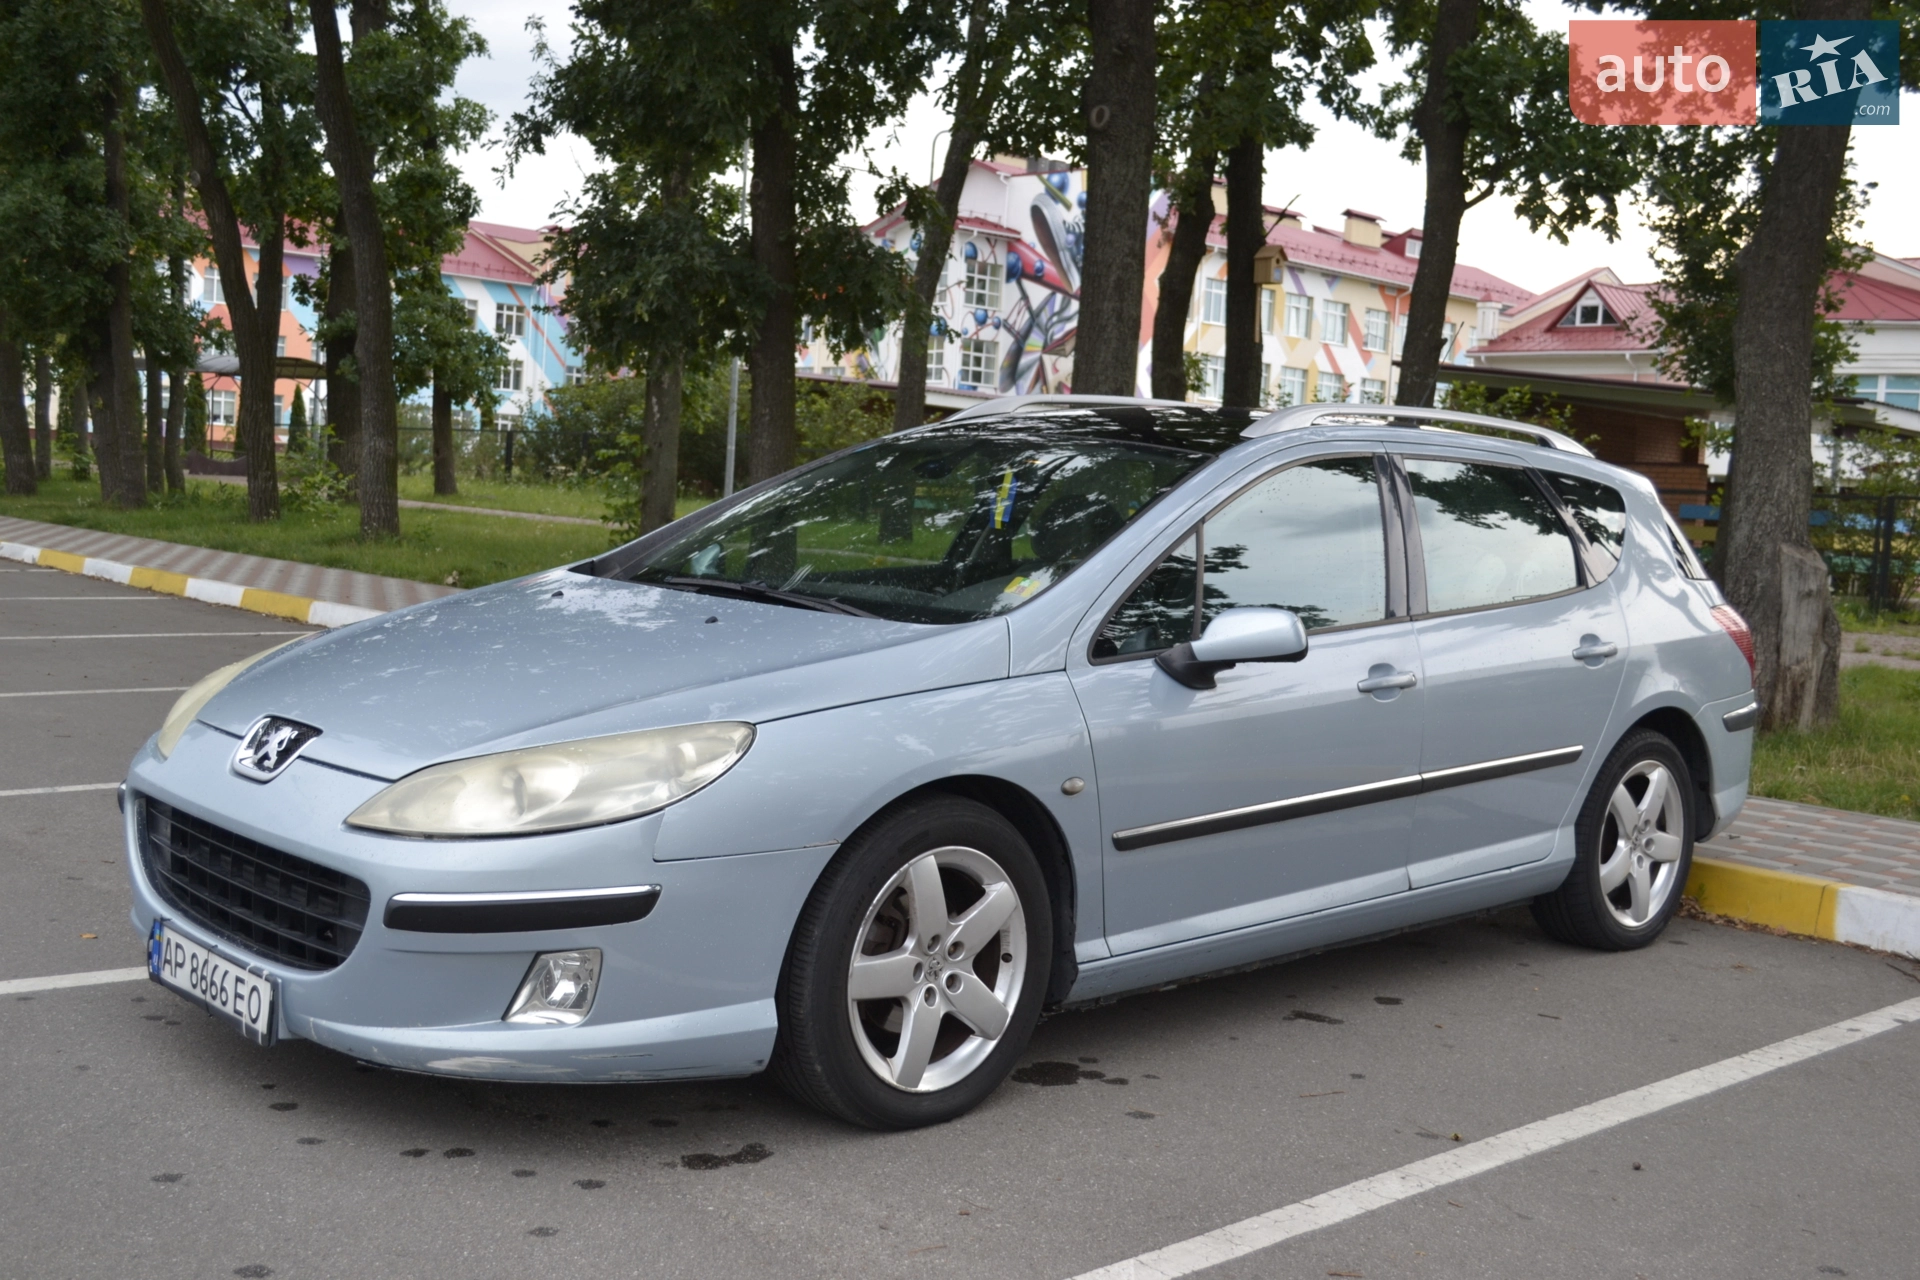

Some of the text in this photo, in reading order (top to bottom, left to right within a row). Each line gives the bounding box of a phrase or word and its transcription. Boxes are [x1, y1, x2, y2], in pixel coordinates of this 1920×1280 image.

[163, 937, 186, 979] AP
[189, 952, 230, 1007] 8666
[233, 974, 262, 1025] EO
